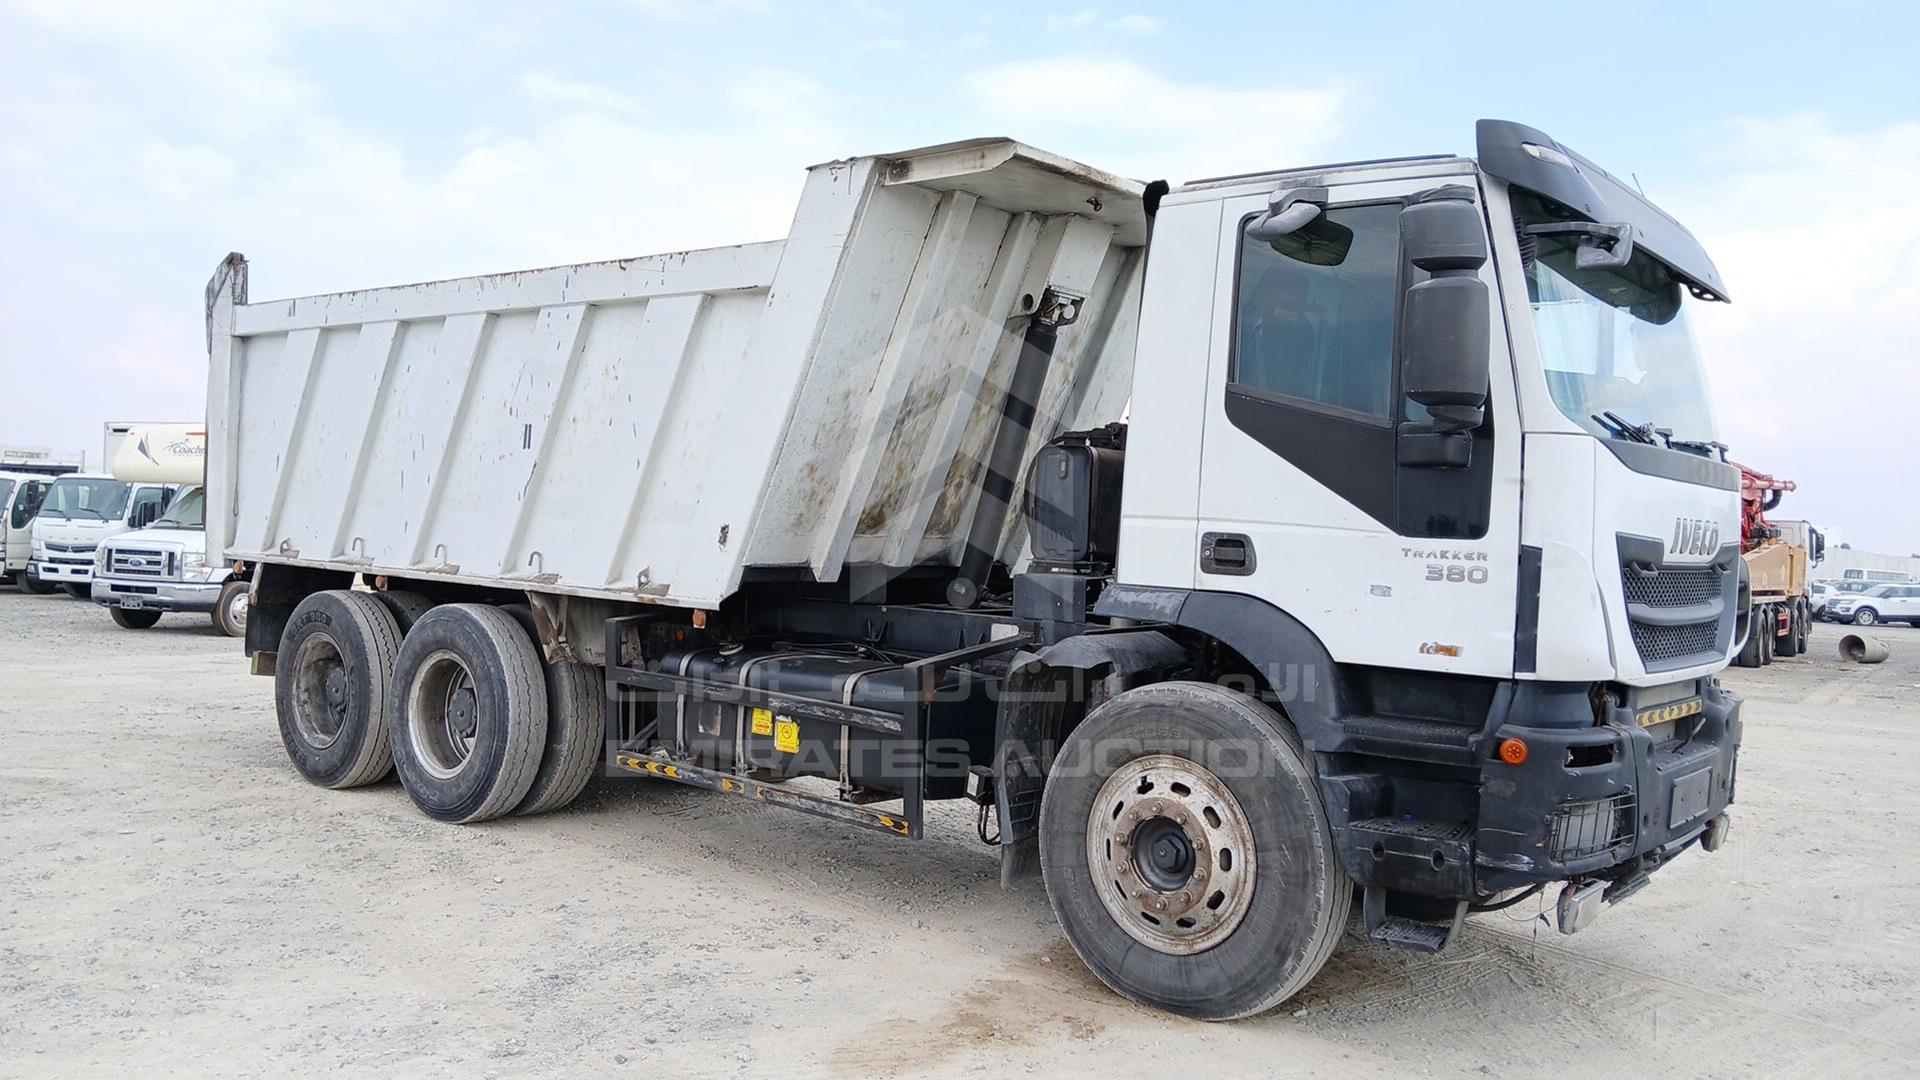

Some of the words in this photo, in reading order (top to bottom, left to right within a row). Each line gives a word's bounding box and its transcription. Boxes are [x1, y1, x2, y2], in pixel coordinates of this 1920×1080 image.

[1669, 517, 1719, 556] IVECO
[1401, 547, 1488, 561] TRAKKER
[1425, 563, 1488, 584] 380
